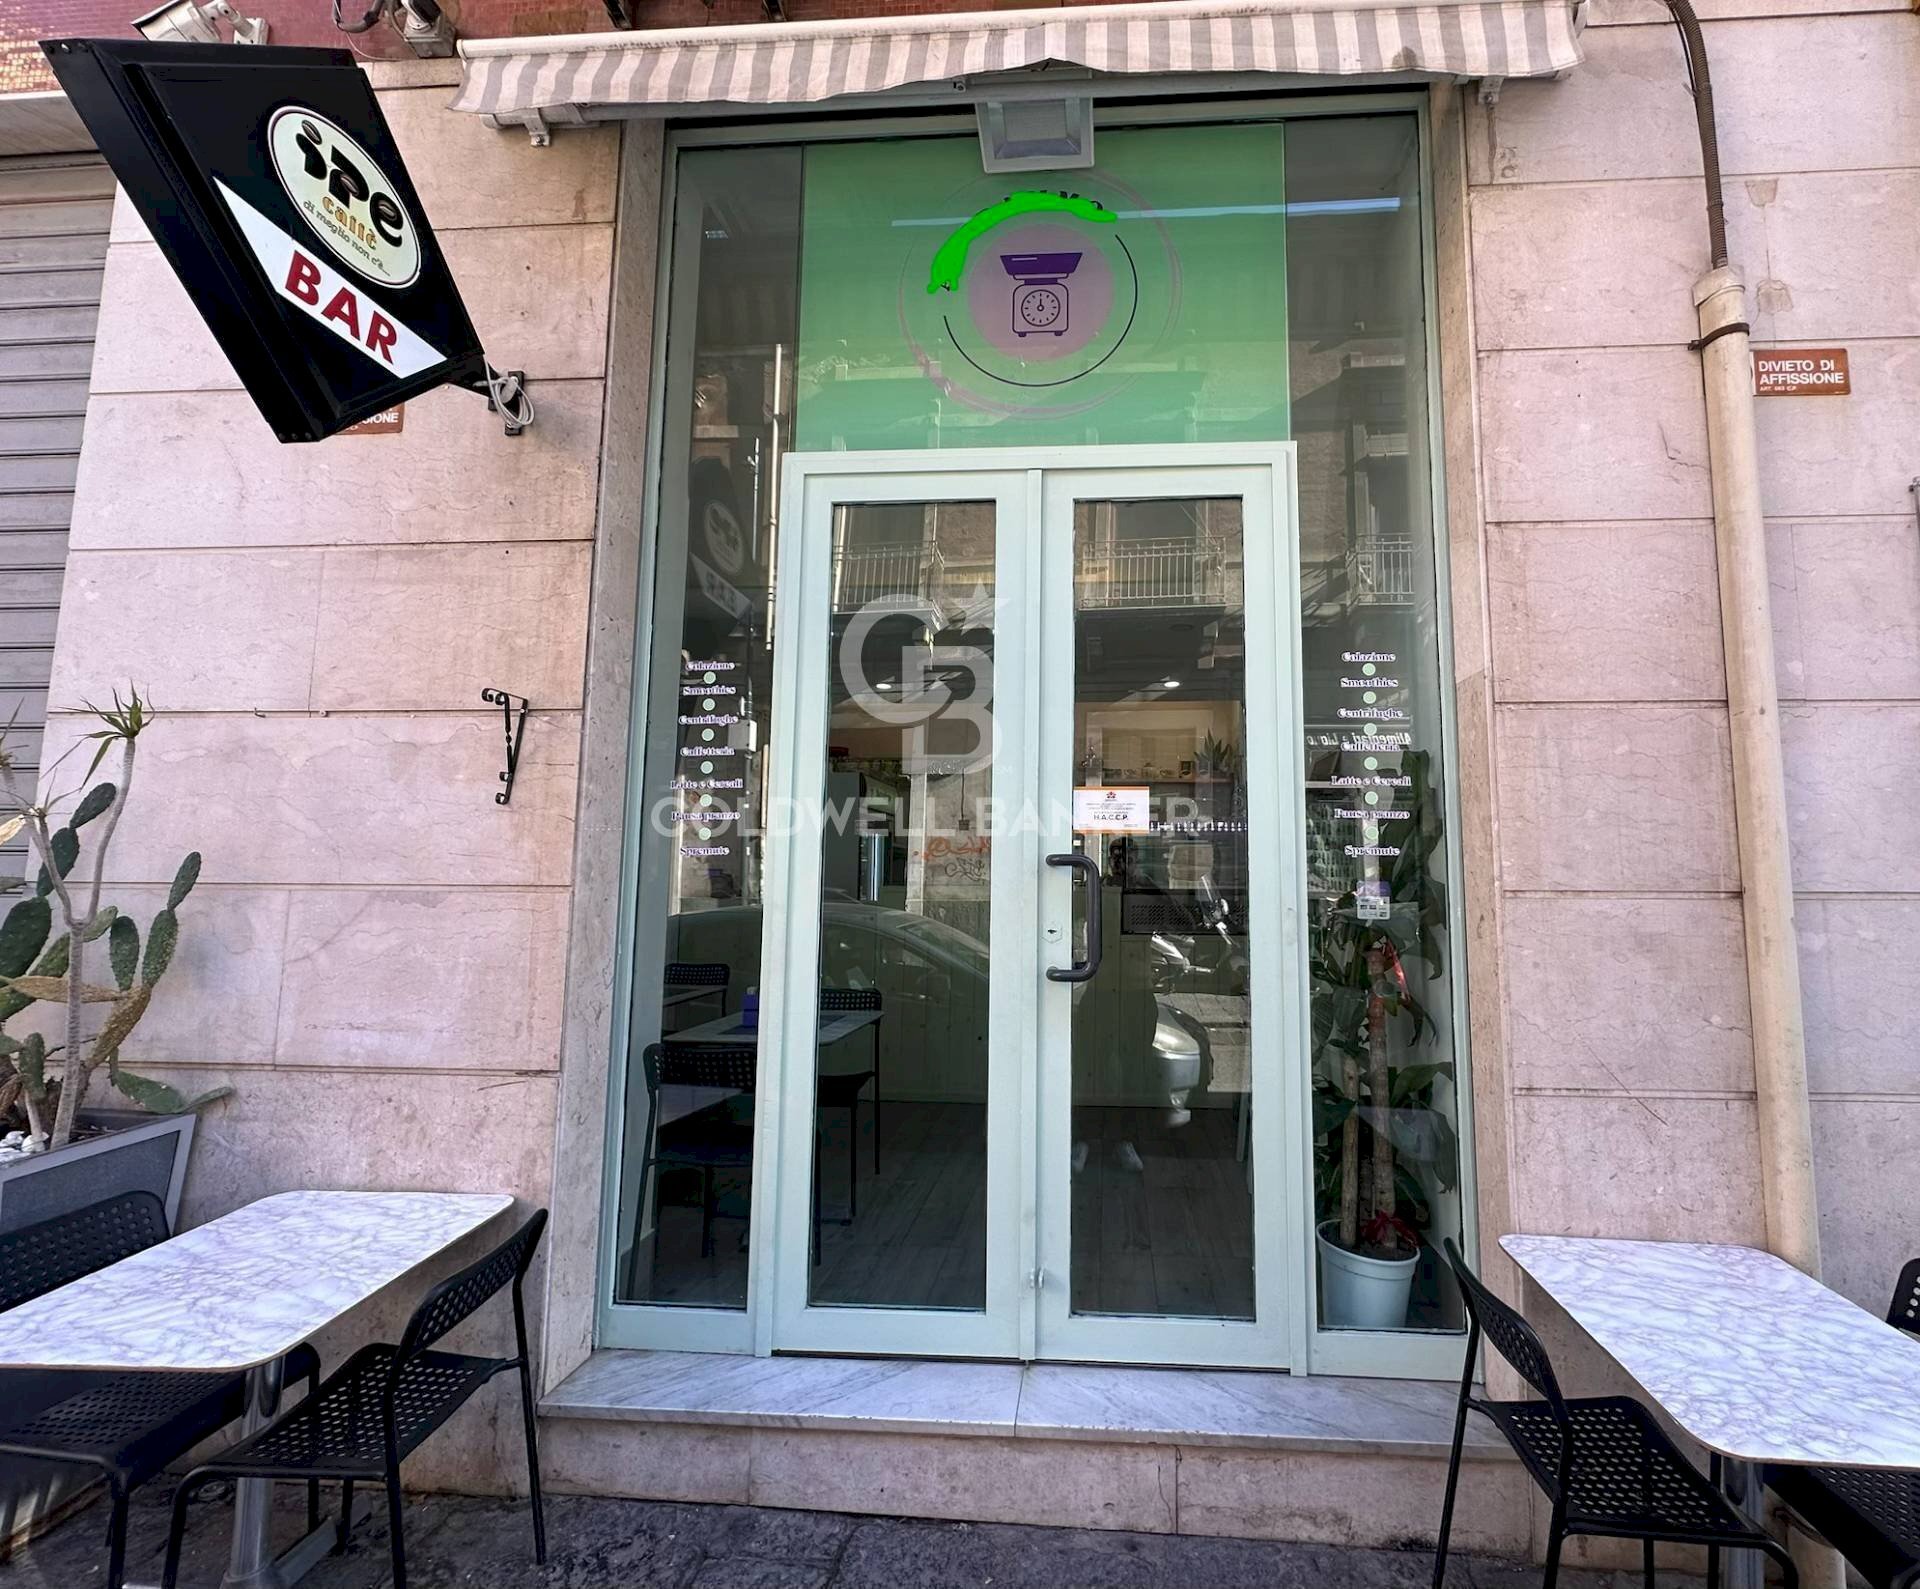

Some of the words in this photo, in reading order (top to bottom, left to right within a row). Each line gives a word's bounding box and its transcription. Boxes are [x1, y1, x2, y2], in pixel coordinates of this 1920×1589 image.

[303, 201, 315, 214] di
[351, 241, 371, 261] non
[285, 250, 397, 365] BAR
[1758, 360, 1814, 372] DIVIETO
[1820, 360, 1834, 371] DI
[1759, 372, 1844, 385] AFFISSIONE
[1342, 652, 1396, 662] Colazione
[685, 661, 735, 671] Colazione
[1340, 677, 1399, 688] Smoothies
[683, 685, 736, 696] Smoothies
[1337, 708, 1403, 721] Centrifughe
[1331, 776, 1361, 786] Latte
[1371, 776, 1412, 786] Cereali
[1334, 808, 1369, 819] Pausa
[680, 846, 730, 858] Spremute
[1344, 845, 1400, 858] Spremute
